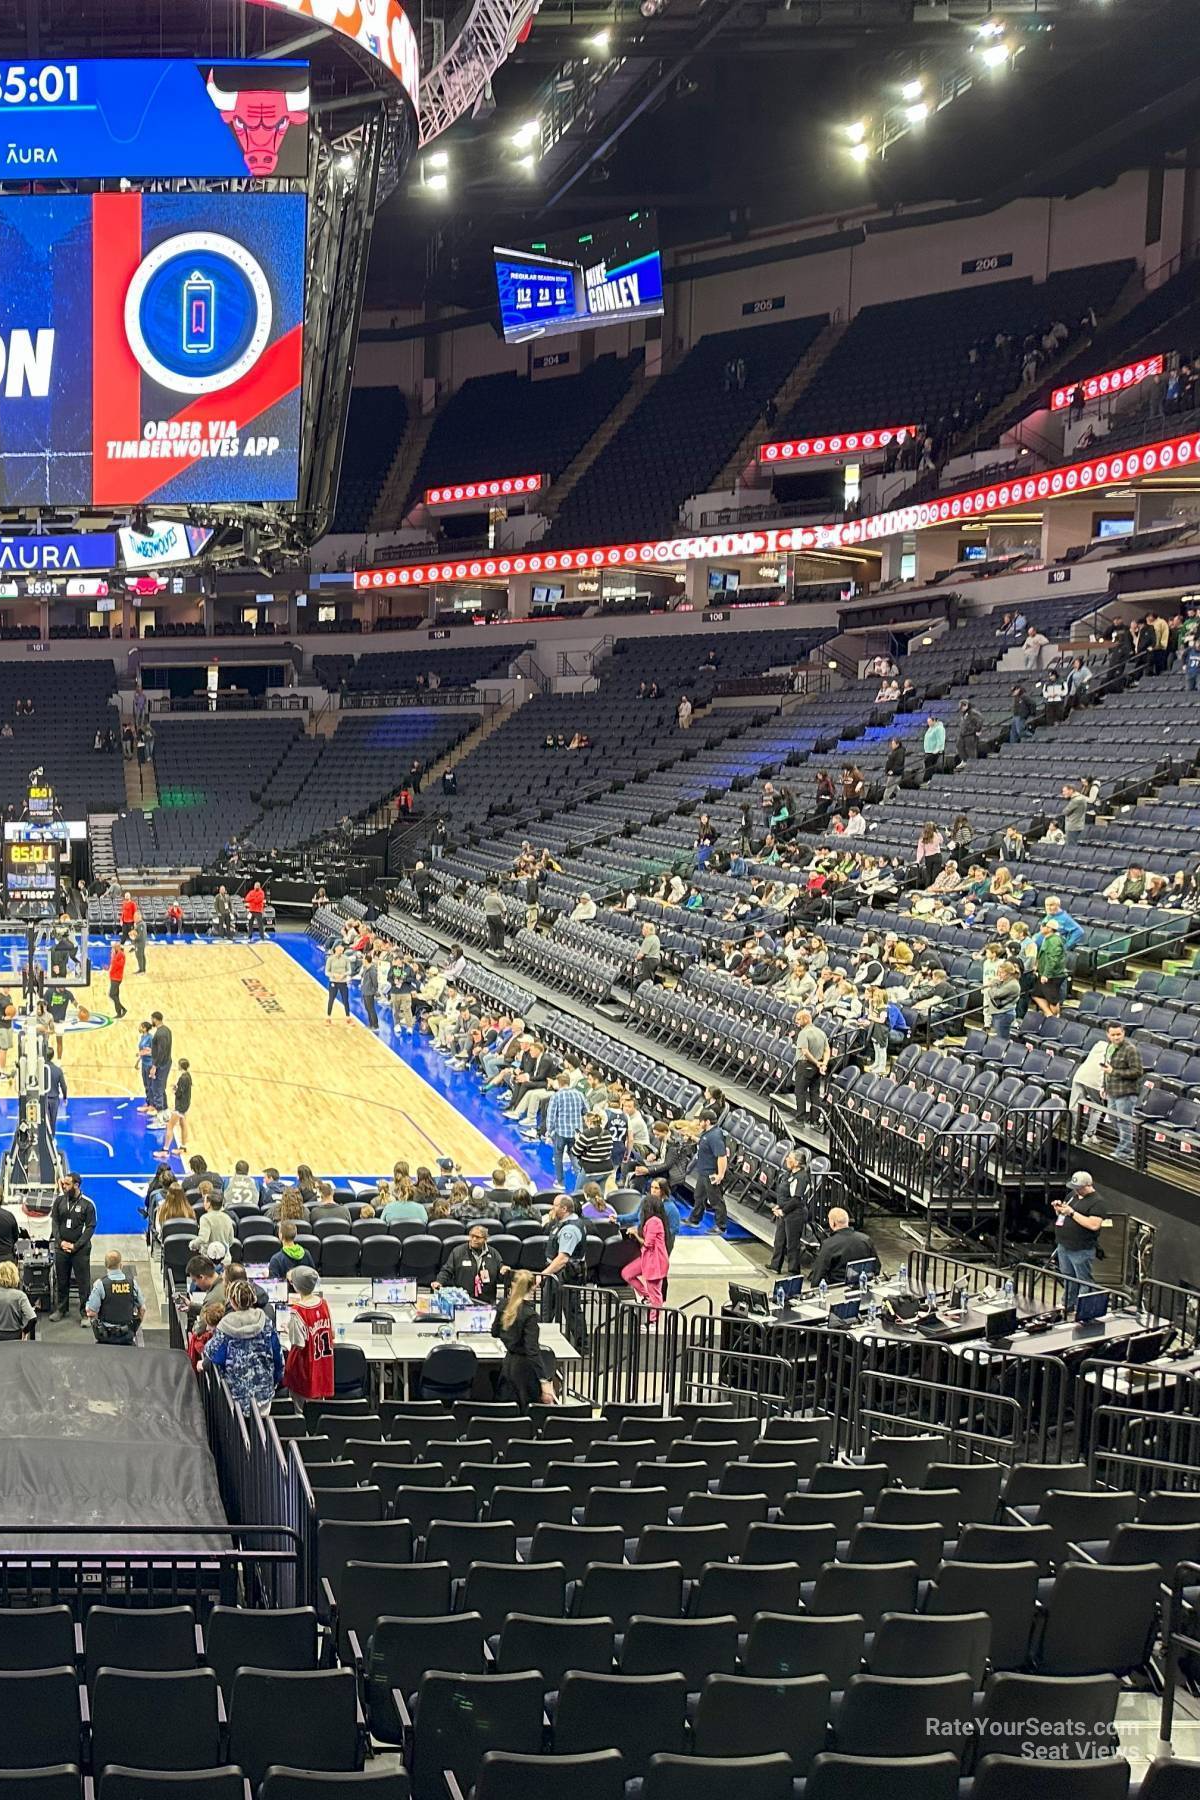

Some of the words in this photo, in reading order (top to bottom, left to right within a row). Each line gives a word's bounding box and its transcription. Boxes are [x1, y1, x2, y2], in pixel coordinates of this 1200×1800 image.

[585, 261, 608, 289] MIKE
[588, 272, 641, 314] CONLEY
[143, 421, 203, 440] ORDER
[208, 420, 238, 439] VIA
[106, 437, 240, 459] TIMBERWOLVES
[243, 437, 280, 457] APP
[1052, 571, 1066, 582] 109
[78, 583, 85, 594] 0
[433, 631, 445, 639] 104
[22, 890, 56, 900] TISSOT
[609, 1126, 627, 1142] 27
[232, 1188, 253, 1204] 32
[111, 1283, 131, 1294] POLICE
[314, 1330, 333, 1361] 11
